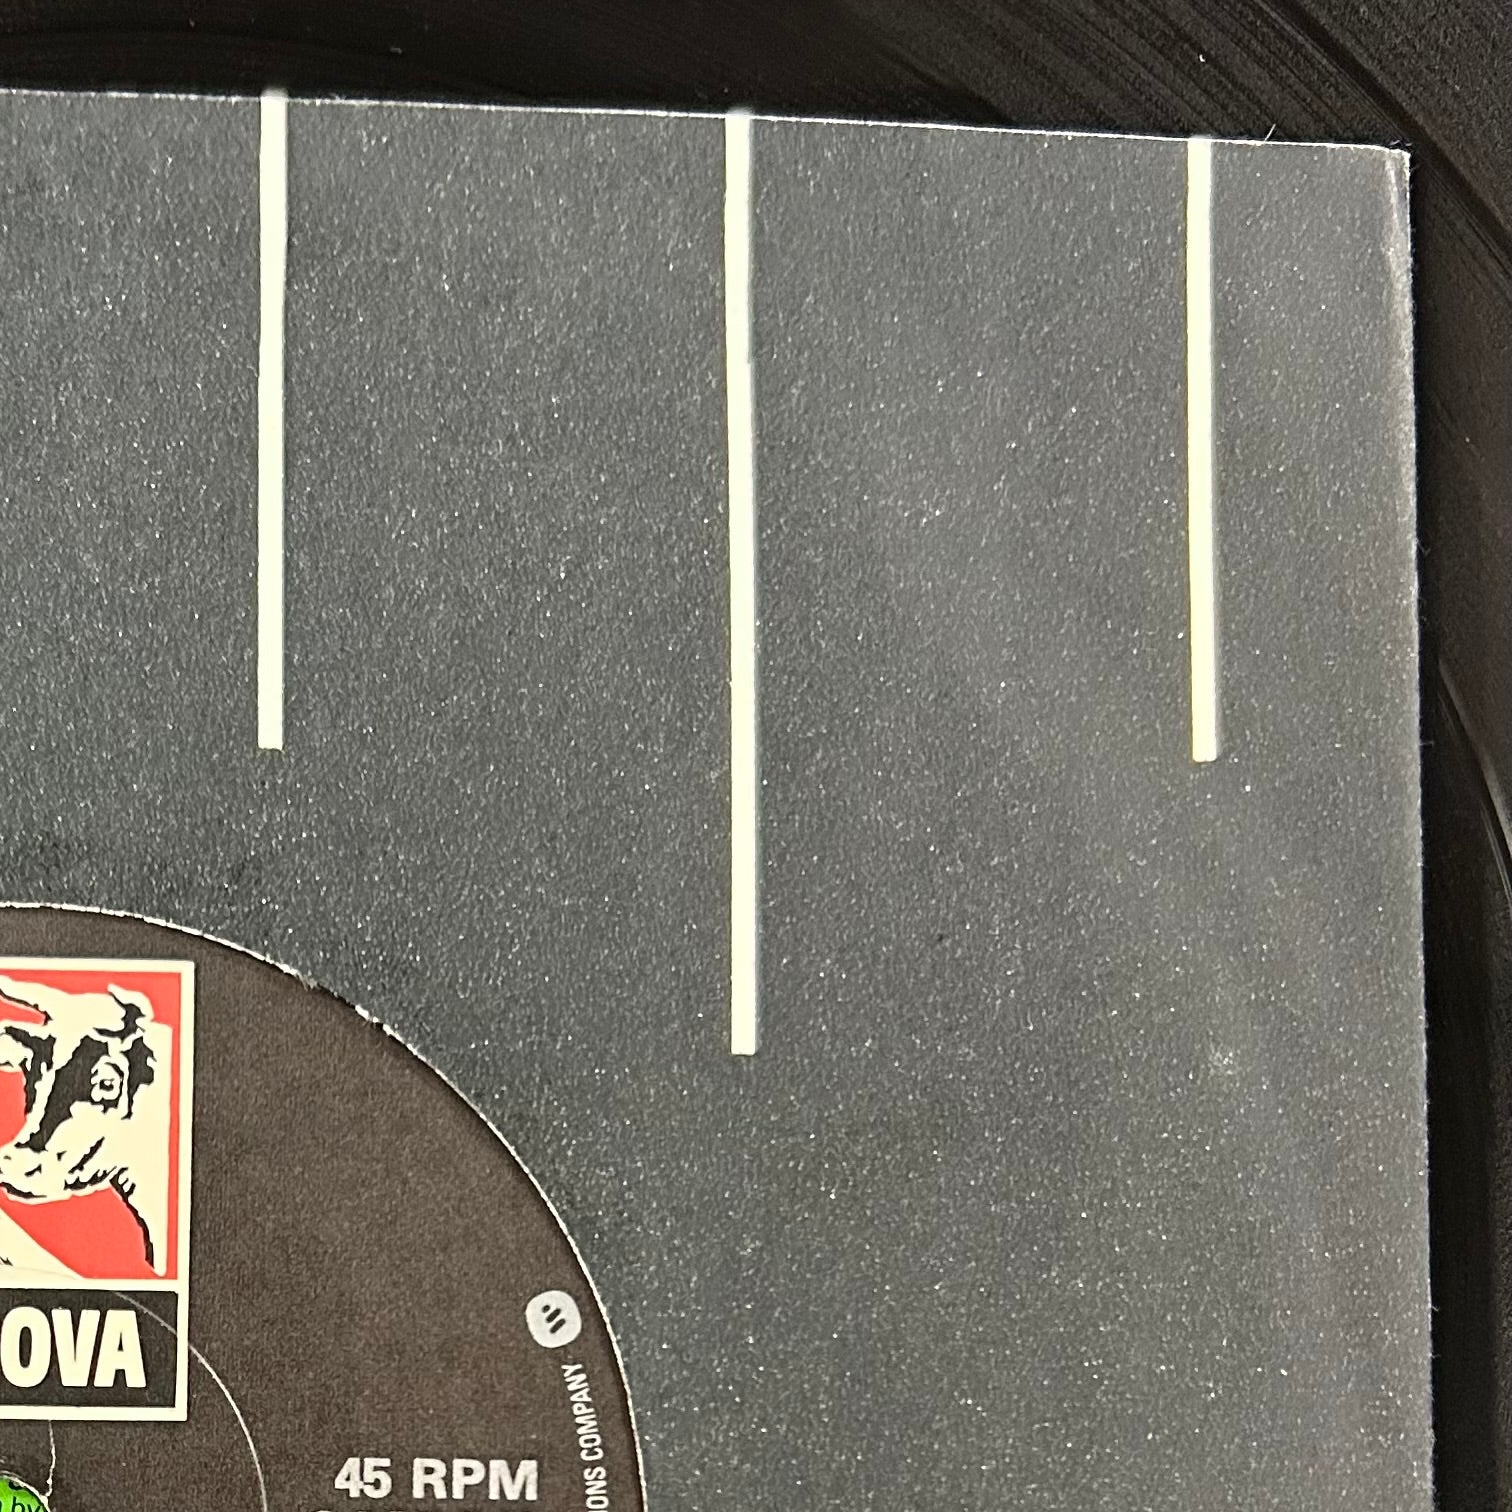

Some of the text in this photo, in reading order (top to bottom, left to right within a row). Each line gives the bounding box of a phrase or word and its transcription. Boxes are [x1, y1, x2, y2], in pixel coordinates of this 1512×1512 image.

[561, 1363, 605, 1462] COMPANY
[334, 1456, 539, 1501] 45 RPM
